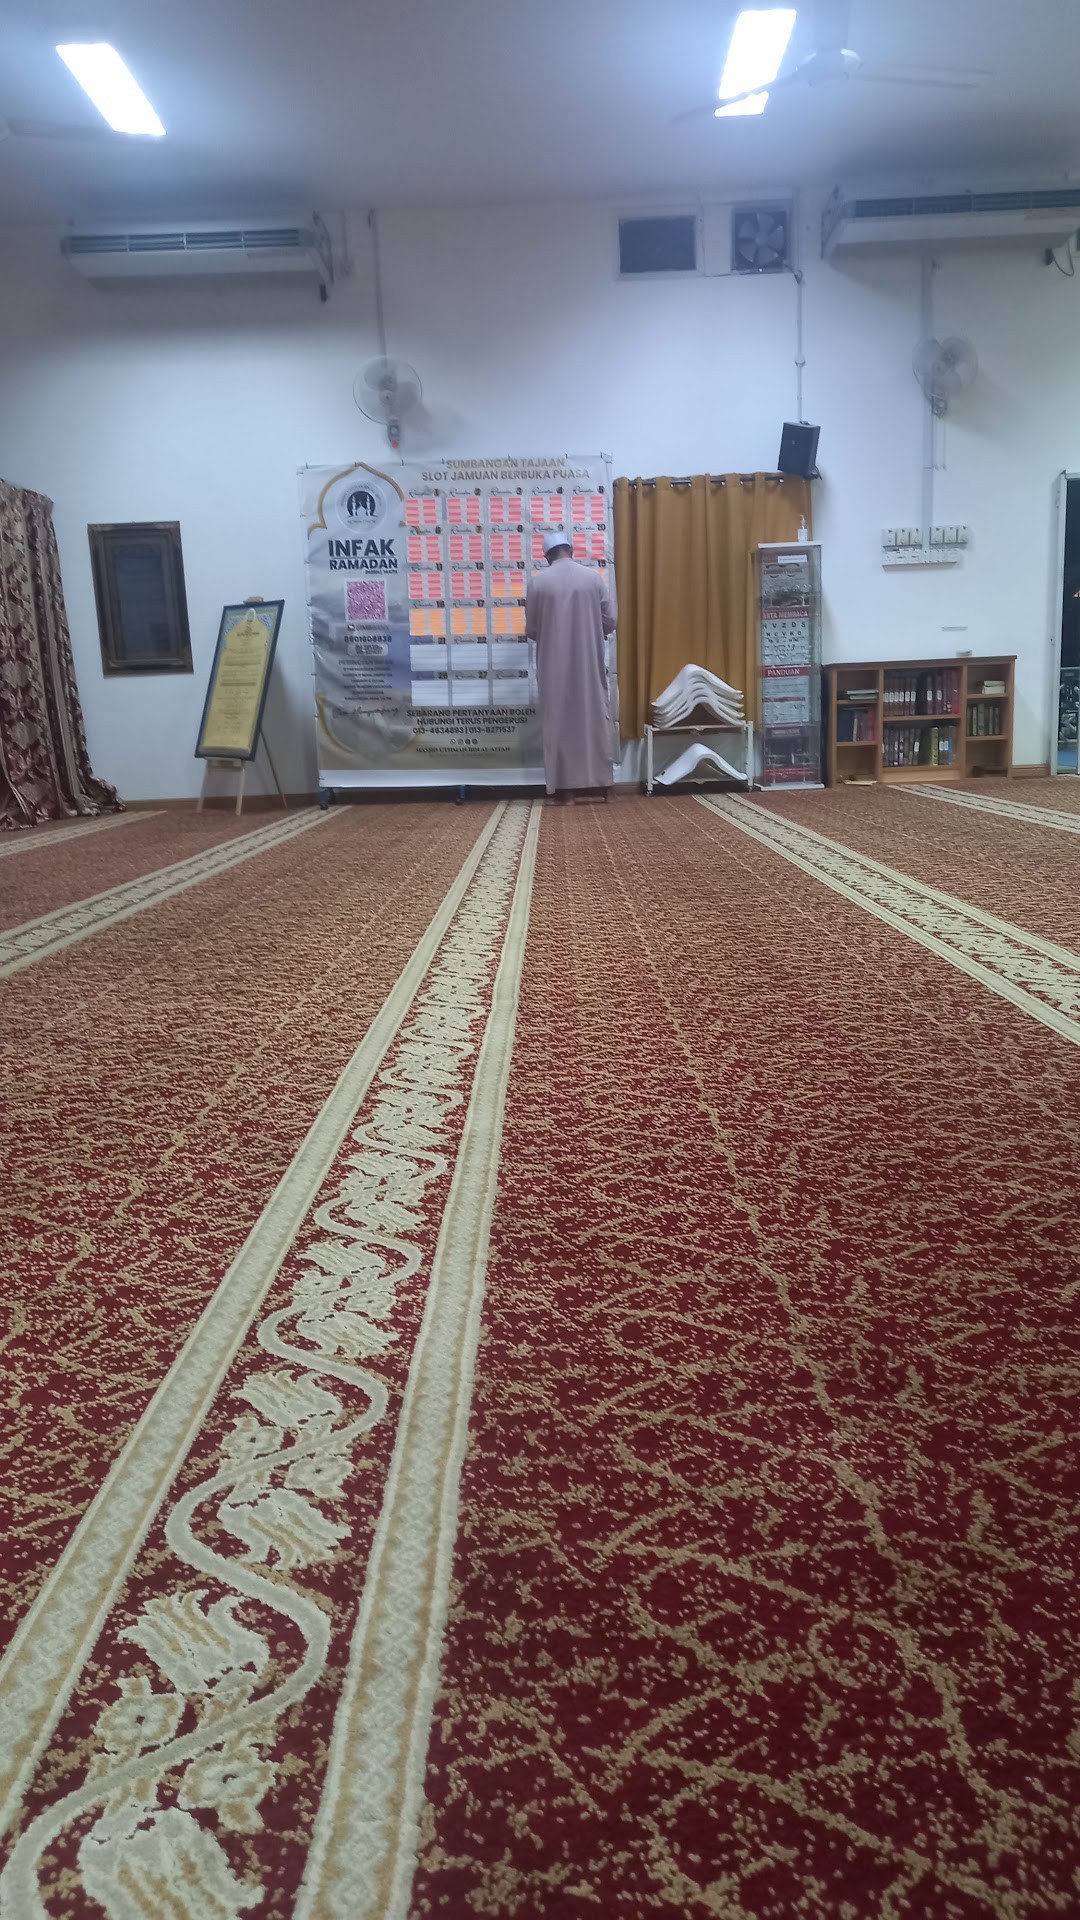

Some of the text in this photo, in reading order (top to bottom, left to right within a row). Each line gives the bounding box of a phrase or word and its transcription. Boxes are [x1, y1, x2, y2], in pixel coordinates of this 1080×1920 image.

[447, 457, 565, 469] SUMBANGAN TAJAAN
[422, 469, 590, 482] SLOT JAMUAN BERBUKA PUASA
[328, 539, 396, 557] INFAK
[329, 558, 398, 571] RAMADAN
[406, 709, 451, 718] SEBARANG
[452, 708, 508, 717] PERTANYAAN
[509, 708, 536, 716] BOLEH
[417, 717, 528, 726] HUBUNGI TERUS PENGERUSI
